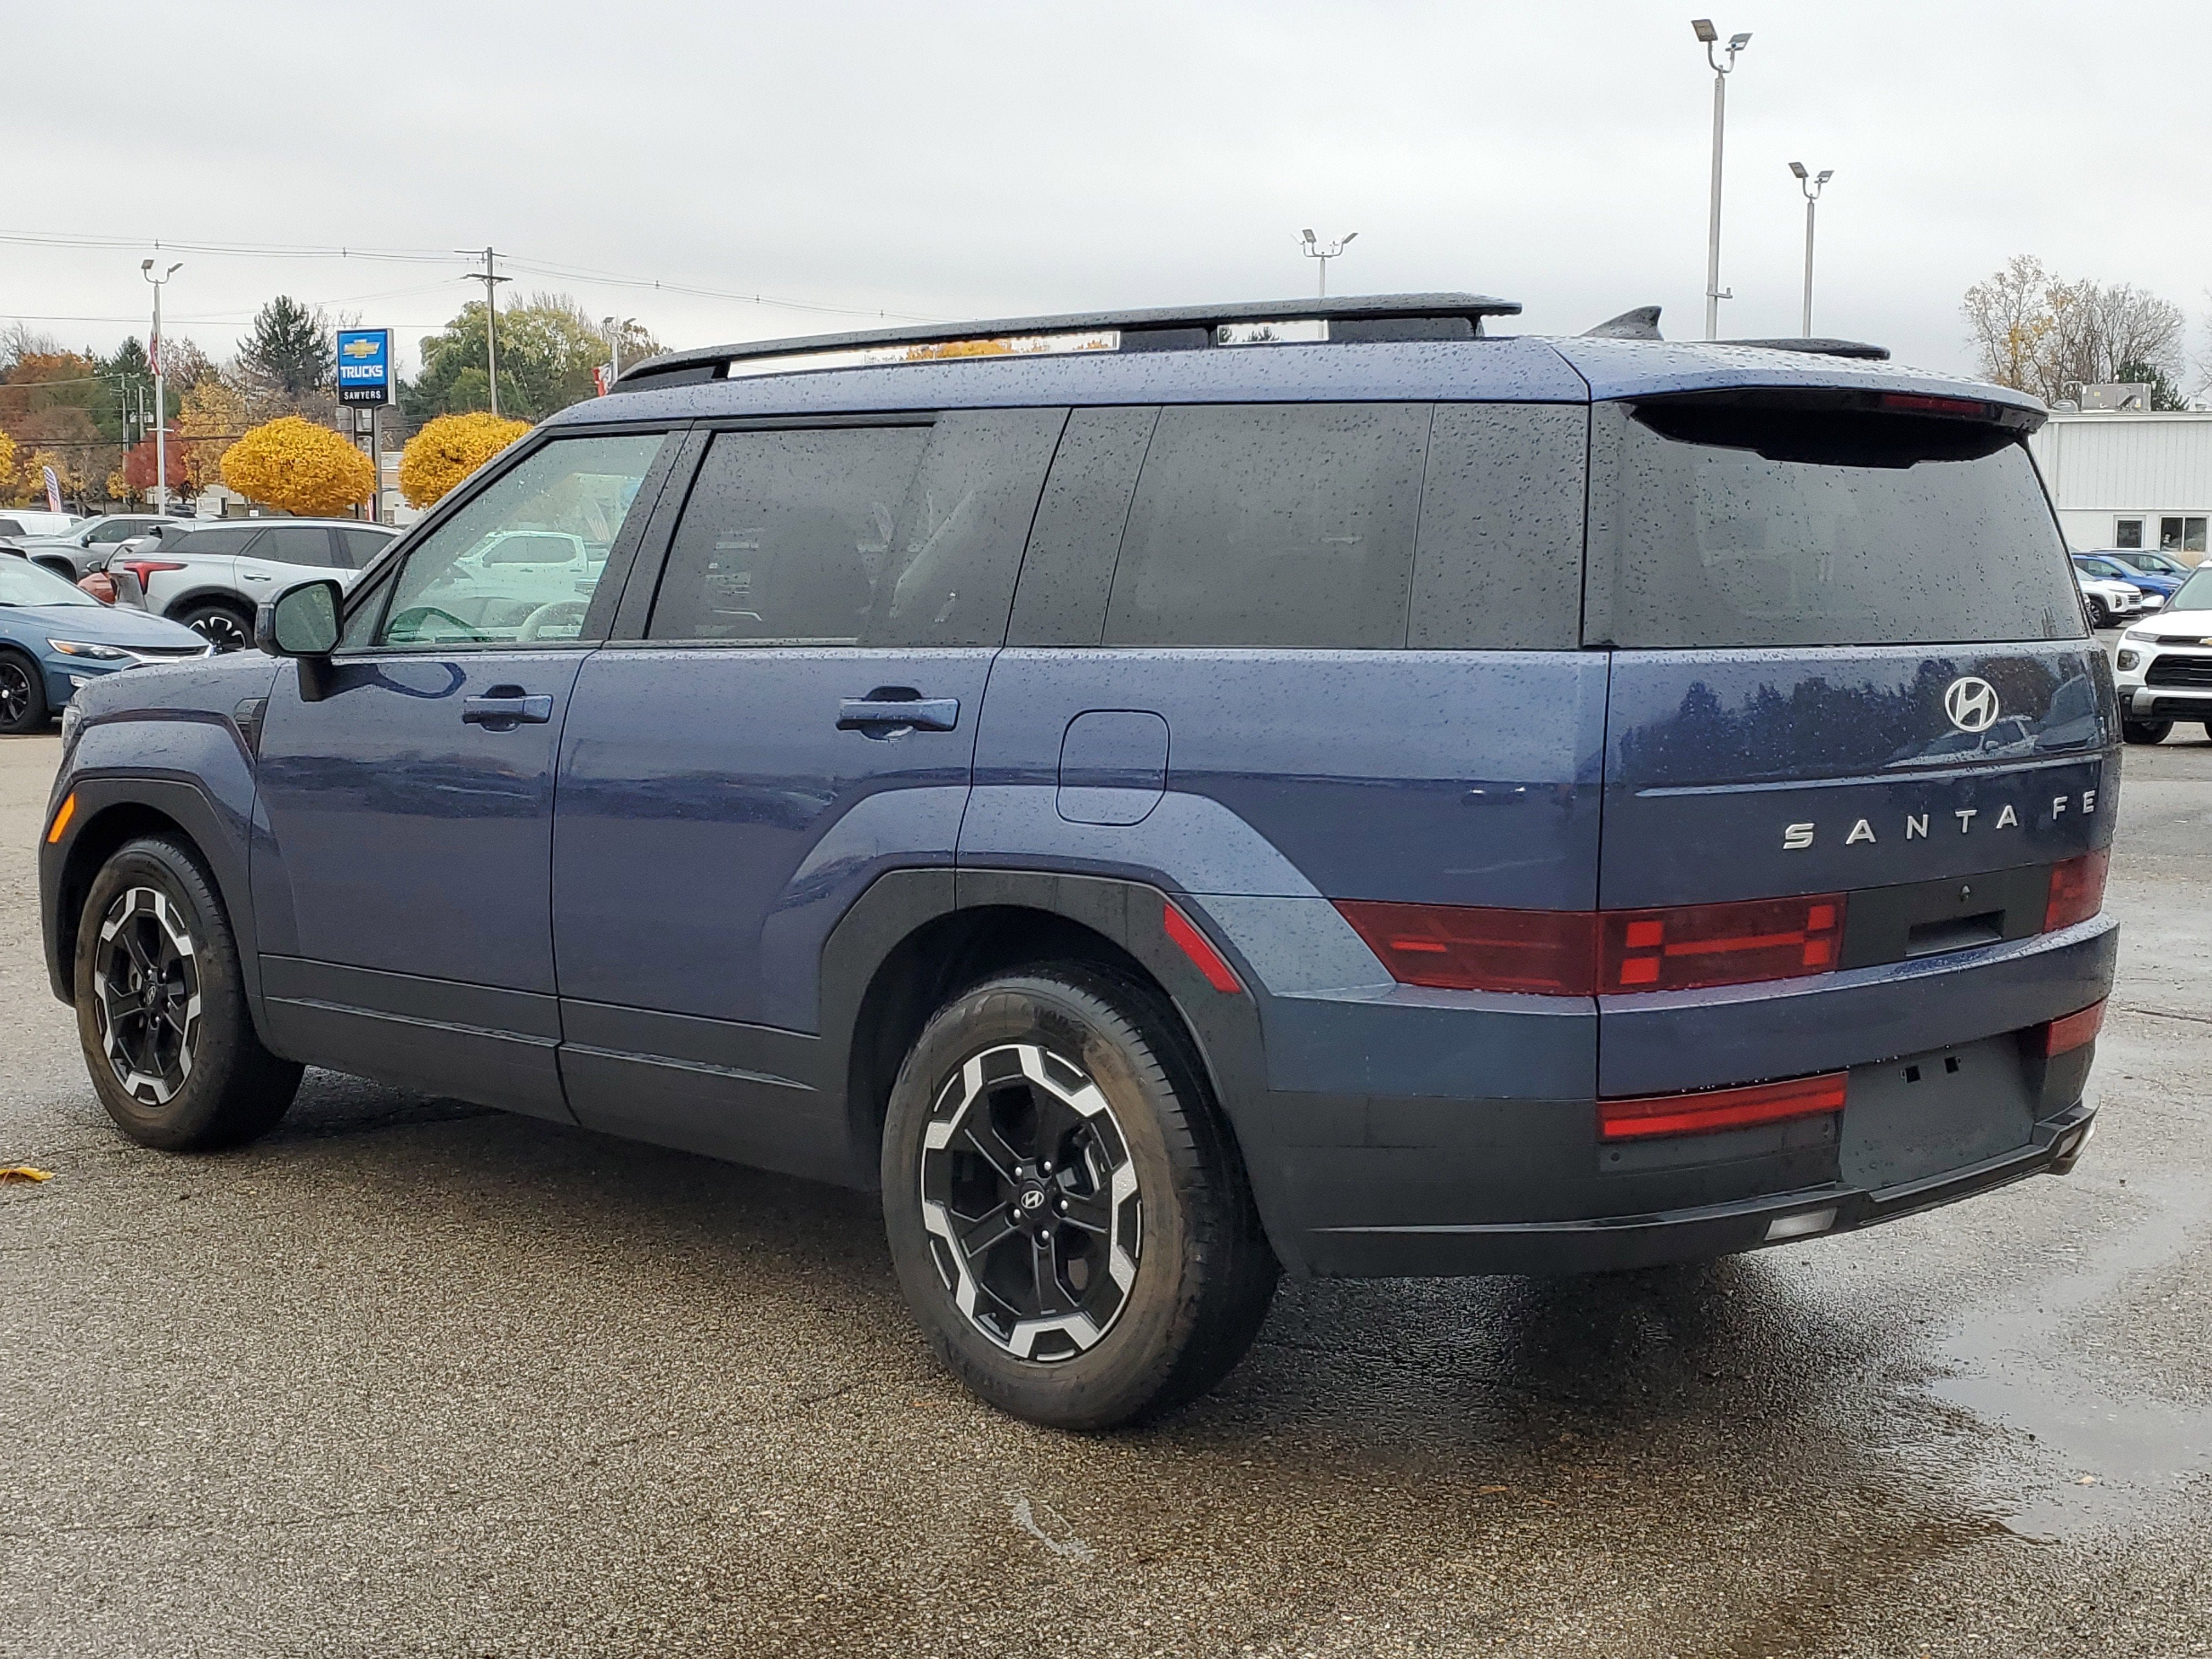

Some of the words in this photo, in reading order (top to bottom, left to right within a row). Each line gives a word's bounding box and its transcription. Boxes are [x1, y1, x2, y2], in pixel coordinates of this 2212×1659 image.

[340, 365, 383, 378] TRUCKS
[344, 391, 381, 400] SAWYERS
[1783, 804, 2018, 849] SANTA
[2052, 790, 2095, 820] FE
